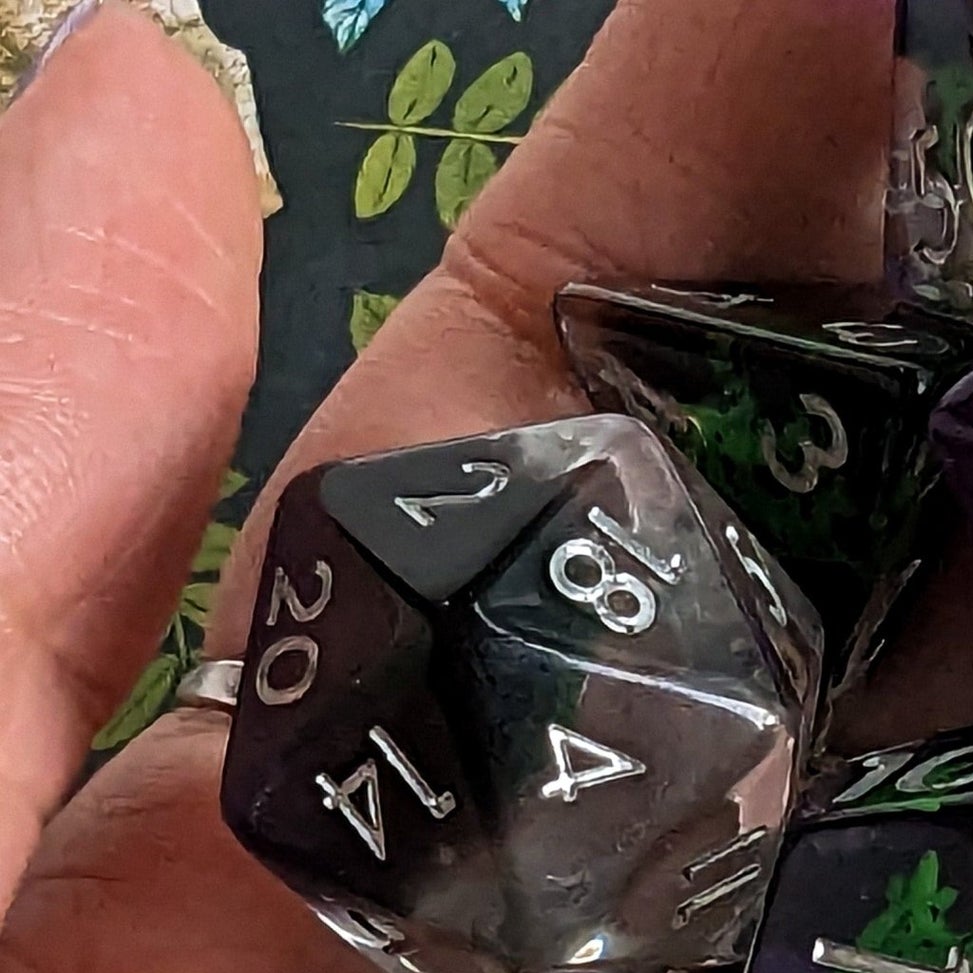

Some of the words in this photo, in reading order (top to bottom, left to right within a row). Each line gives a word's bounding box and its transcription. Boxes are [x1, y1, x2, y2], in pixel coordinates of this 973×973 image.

[394, 461, 512, 527] 2
[762, 394, 848, 493] 3
[549, 506, 686, 635] 18
[255, 559, 333, 706] 20
[314, 725, 457, 862] 14
[542, 723, 647, 803] 4
